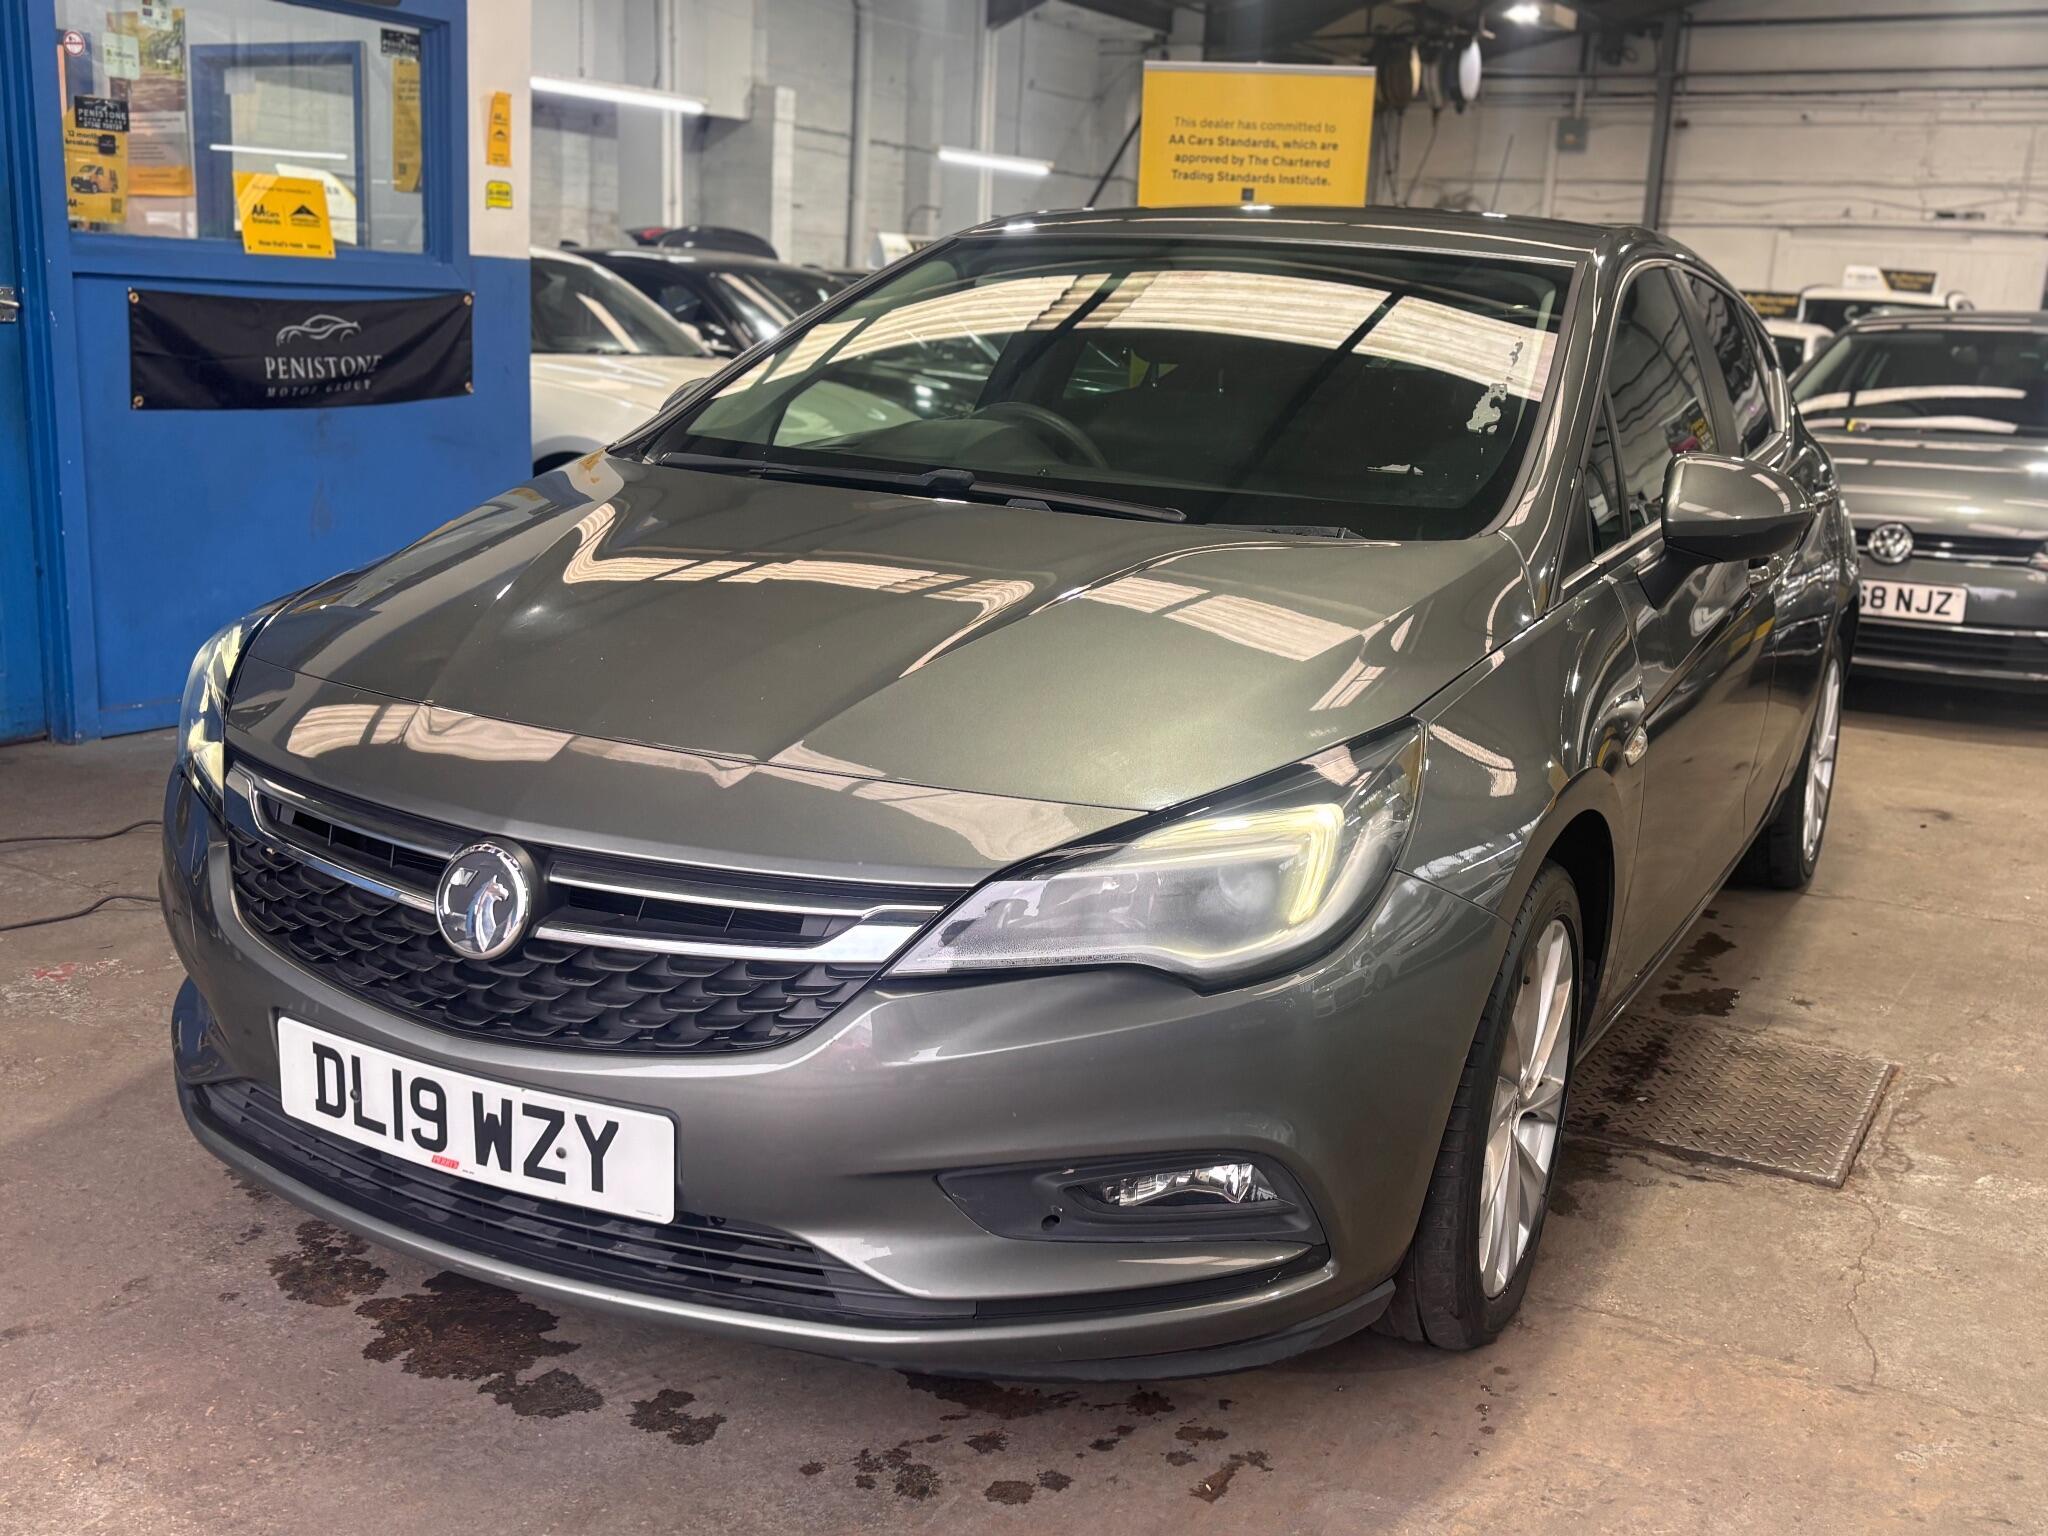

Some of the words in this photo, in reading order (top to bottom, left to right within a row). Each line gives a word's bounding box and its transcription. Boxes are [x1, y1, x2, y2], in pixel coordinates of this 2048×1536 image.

[1174, 117, 1197, 128] This
[1200, 118, 1235, 129] dealer
[1238, 119, 1258, 131] has
[1260, 120, 1323, 133] committed
[1325, 123, 1337, 134] to
[1169, 134, 1185, 145] AA
[1188, 135, 1214, 146] Cars
[1217, 135, 1280, 149] Standards,
[1283, 138, 1317, 149] which
[1320, 141, 1338, 151] are
[1174, 153, 1229, 165] approved
[1231, 154, 1245, 167] by
[1248, 155, 1269, 166] The
[1271, 156, 1330, 168] Chartered
[1172, 169, 1214, 184] Trading
[1217, 170, 1276, 184] Standards
[1279, 175, 1331, 187] Institute.
[1895, 587, 1954, 616] NJZ
[312, 1041, 448, 1153] DL19
[471, 1090, 620, 1194] WZY
